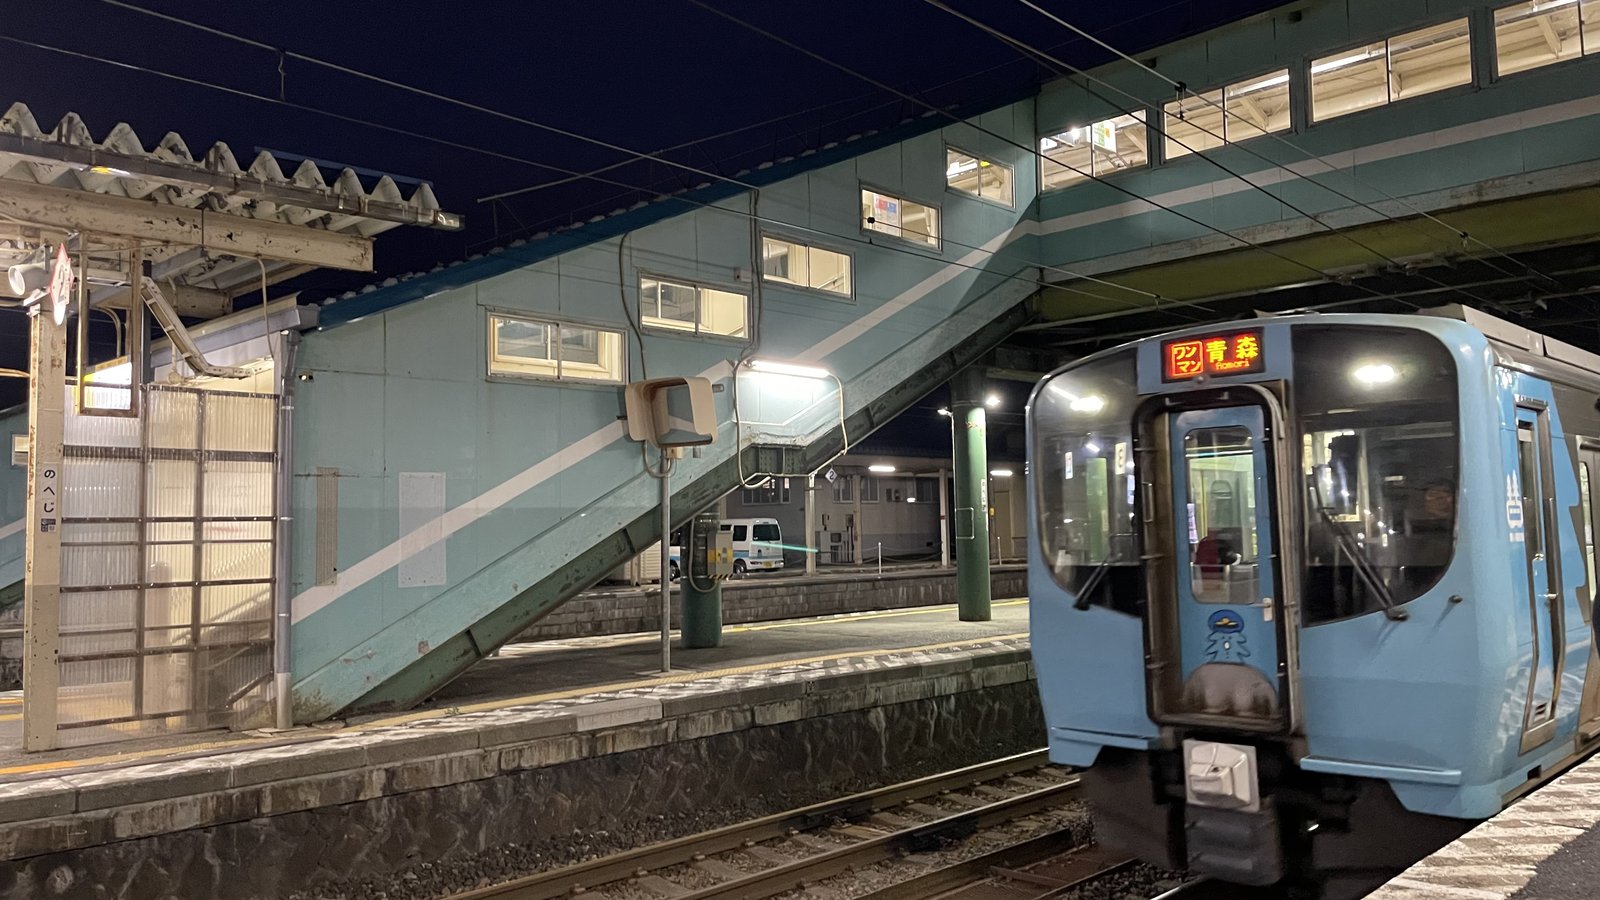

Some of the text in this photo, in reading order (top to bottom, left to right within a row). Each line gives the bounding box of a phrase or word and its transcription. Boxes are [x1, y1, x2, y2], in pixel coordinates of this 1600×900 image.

[57, 264, 65, 303] 2
[1173, 345, 1197, 359] ワン
[1205, 336, 1258, 363] 青森
[1176, 360, 1201, 372] マン
[829, 470, 835, 480] 2
[43, 469, 56, 513] のへじ
